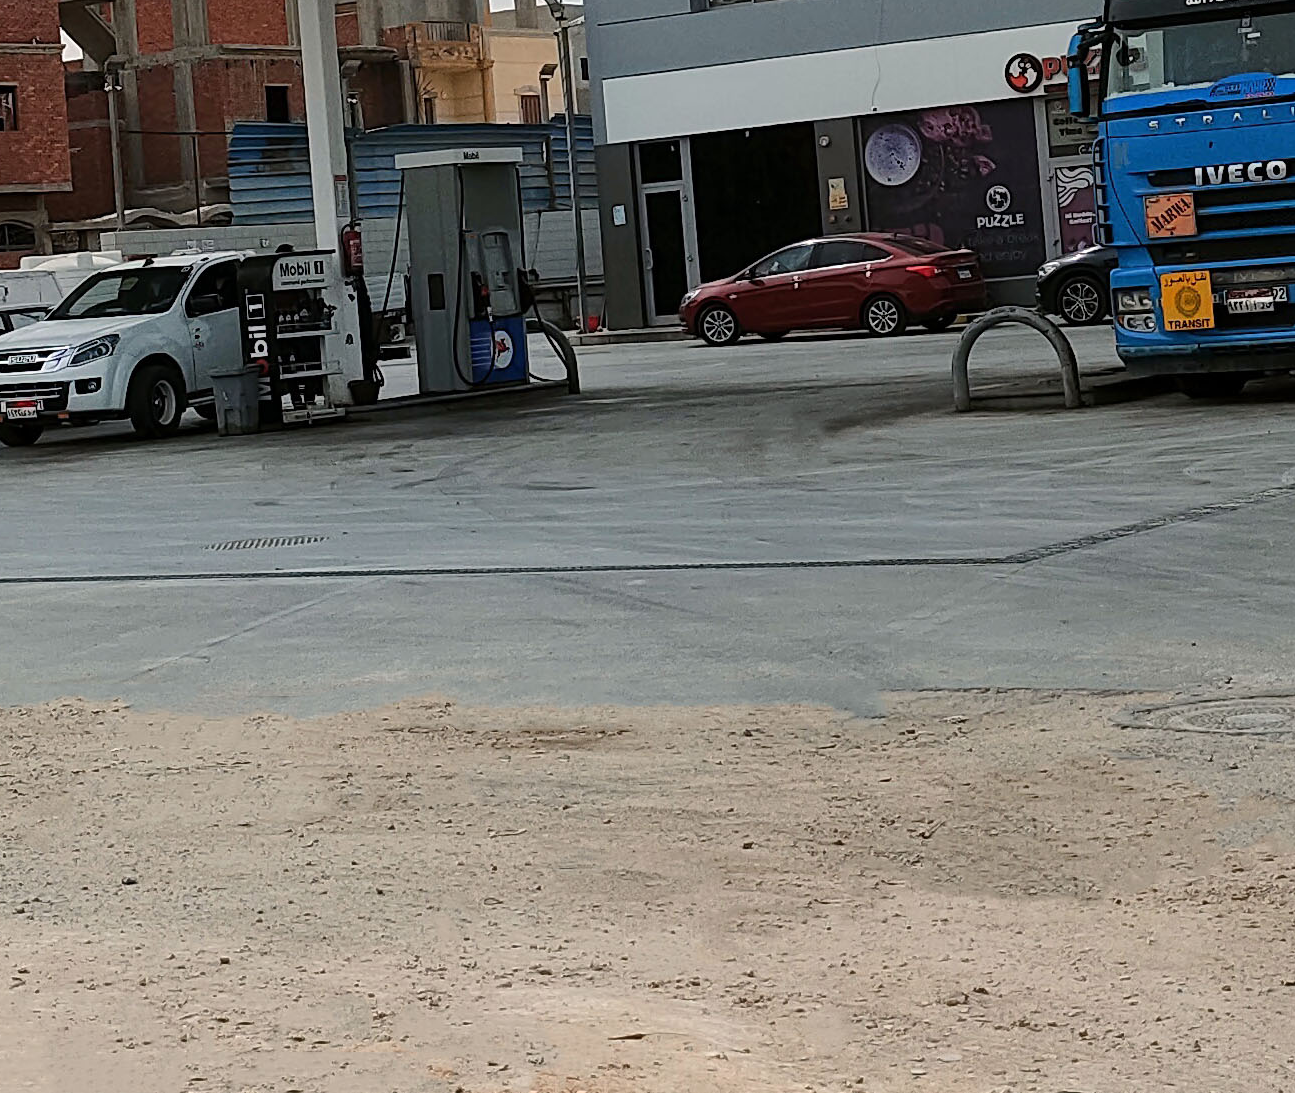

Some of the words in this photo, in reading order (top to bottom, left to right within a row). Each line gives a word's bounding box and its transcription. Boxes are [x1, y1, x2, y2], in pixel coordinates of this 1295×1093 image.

[1194, 160, 1287, 186] IVECO
[976, 213, 1025, 229] PUZZLE
[280, 261, 311, 277] Mobil
[314, 261, 324, 274] 1
[1168, 318, 1211, 329] TRANSIT
